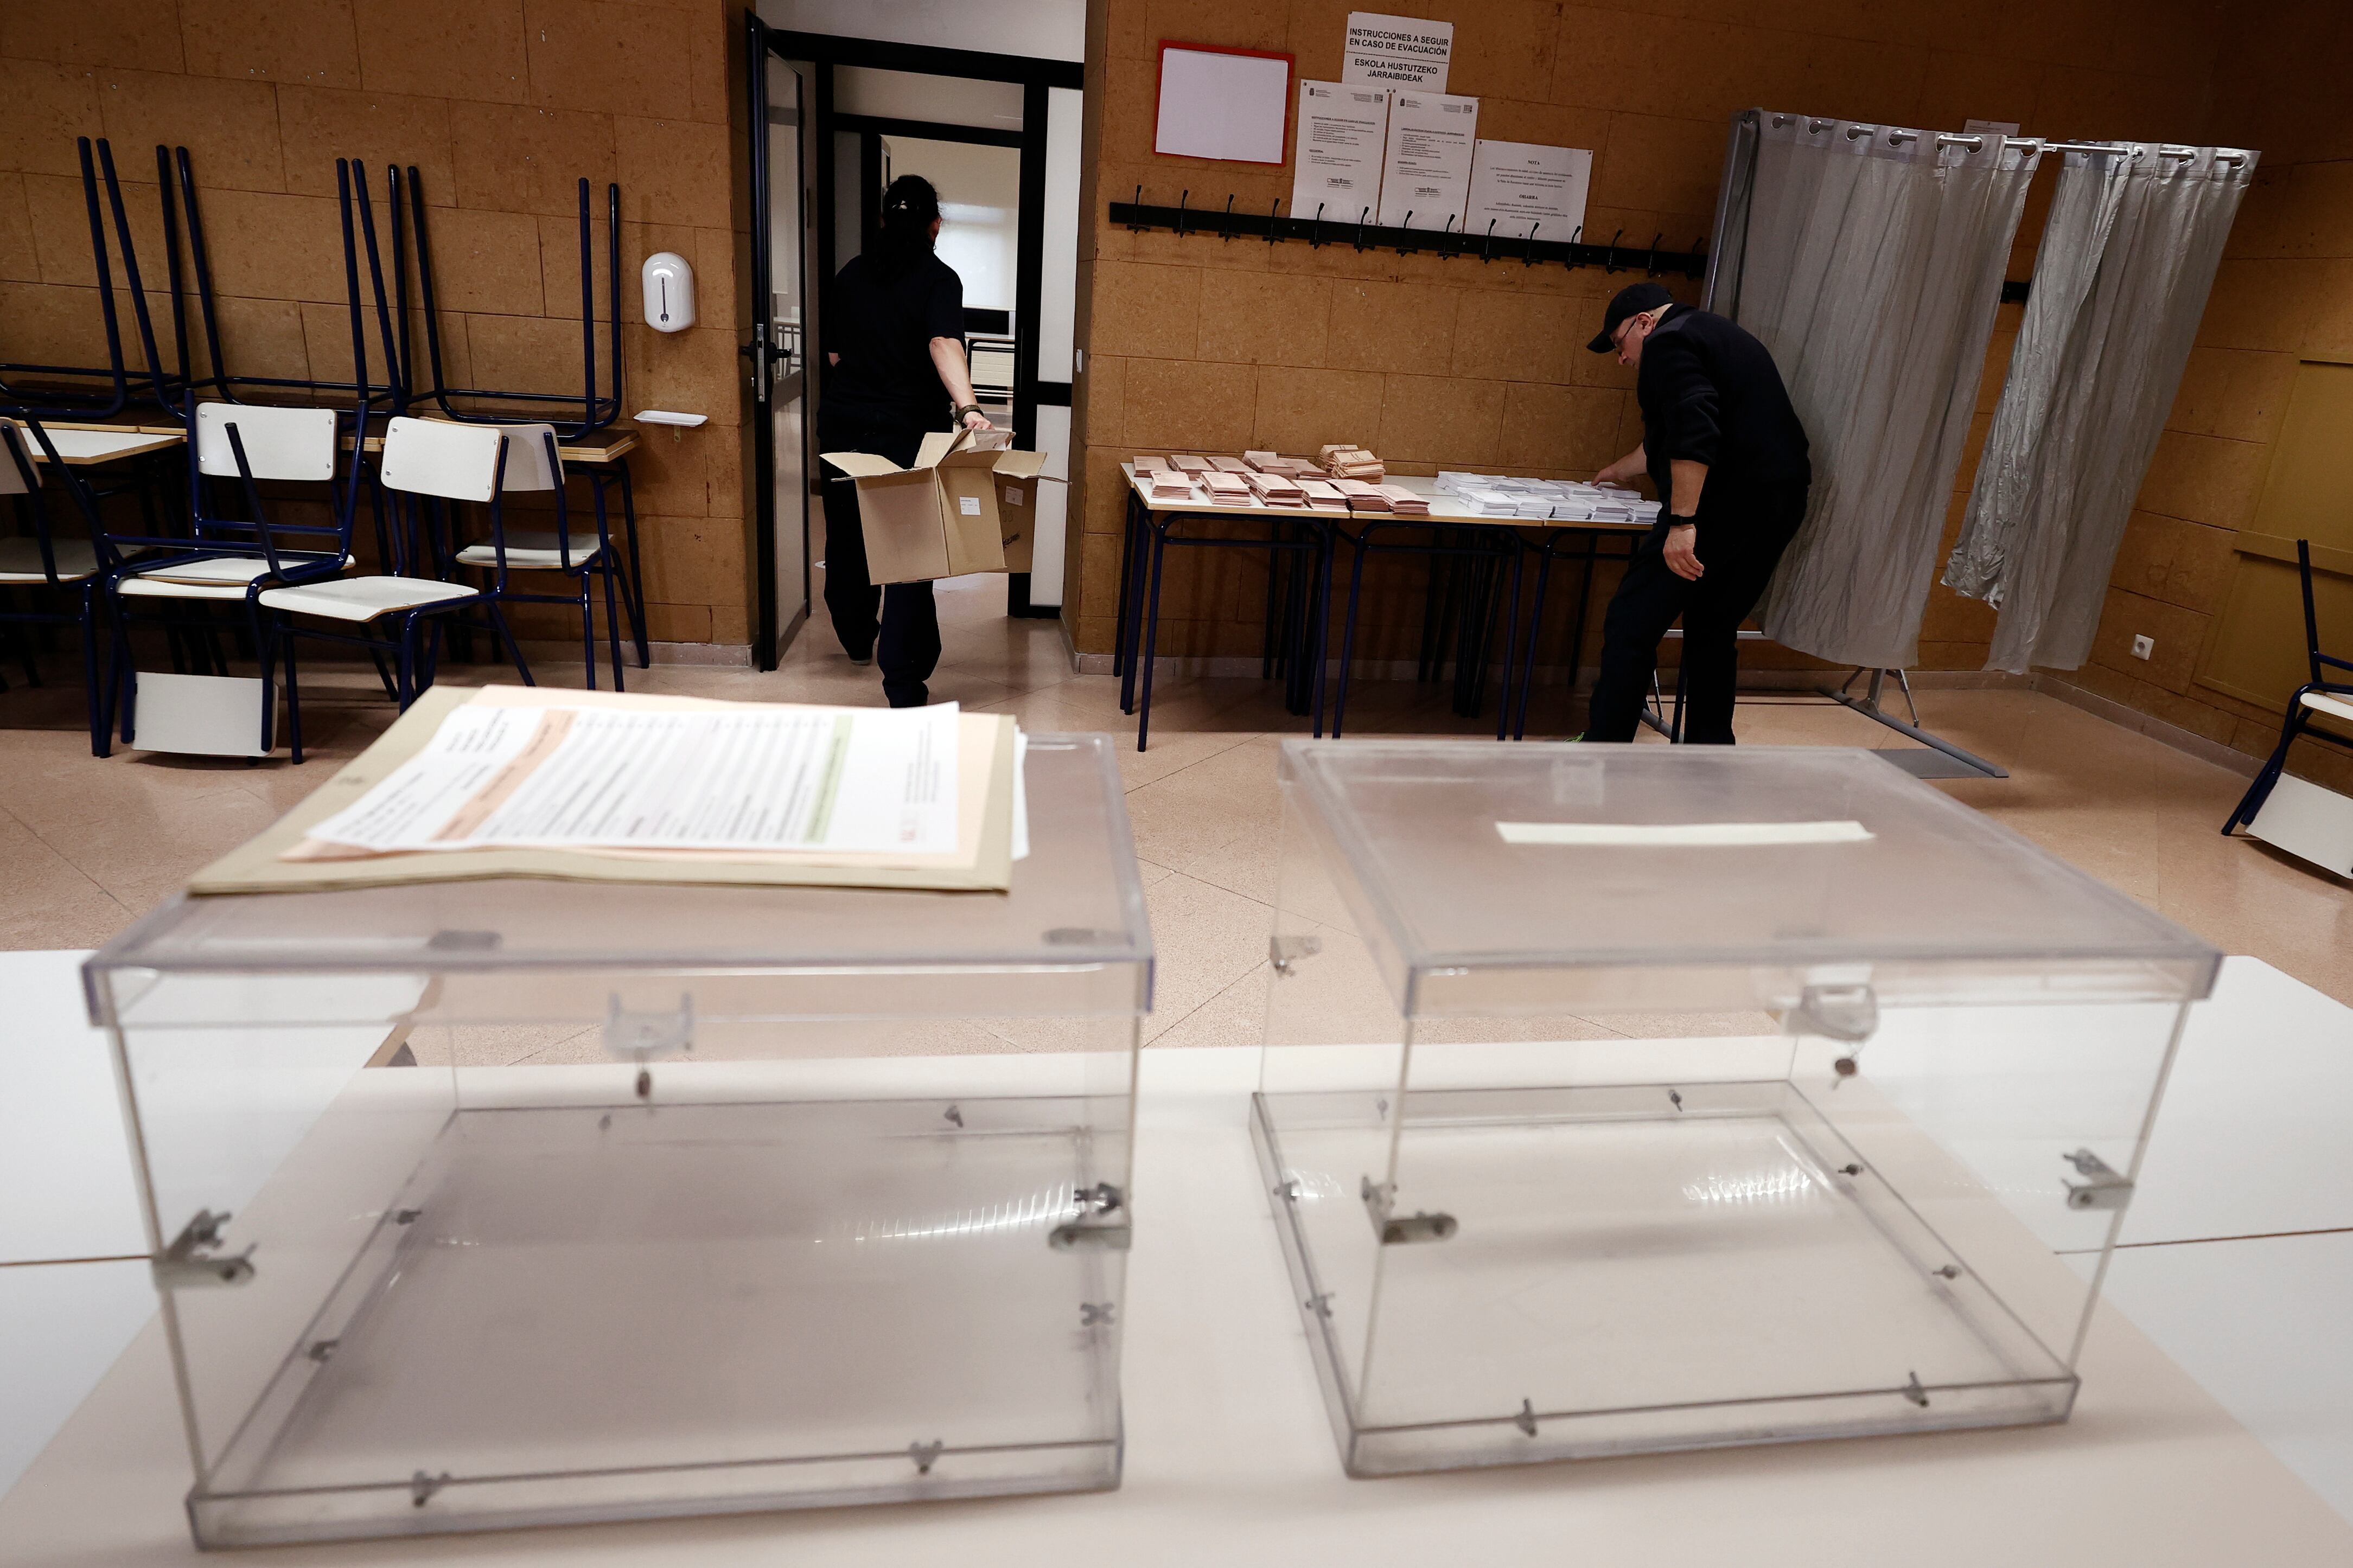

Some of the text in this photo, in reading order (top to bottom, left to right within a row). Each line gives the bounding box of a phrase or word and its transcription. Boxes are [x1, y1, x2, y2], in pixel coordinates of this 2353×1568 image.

[1349, 28, 1411, 42] INSTRUCCIONES
[1420, 36, 1449, 46] SEGUIR
[1362, 39, 1383, 48] CASO
[1386, 42, 1395, 50] DE
[1398, 43, 1447, 56] EVACUACIÓN
[1355, 59, 1438, 74] ESKOLA HUSTUTZEKO
[1367, 70, 1423, 82] JARRAIBIDEAK
